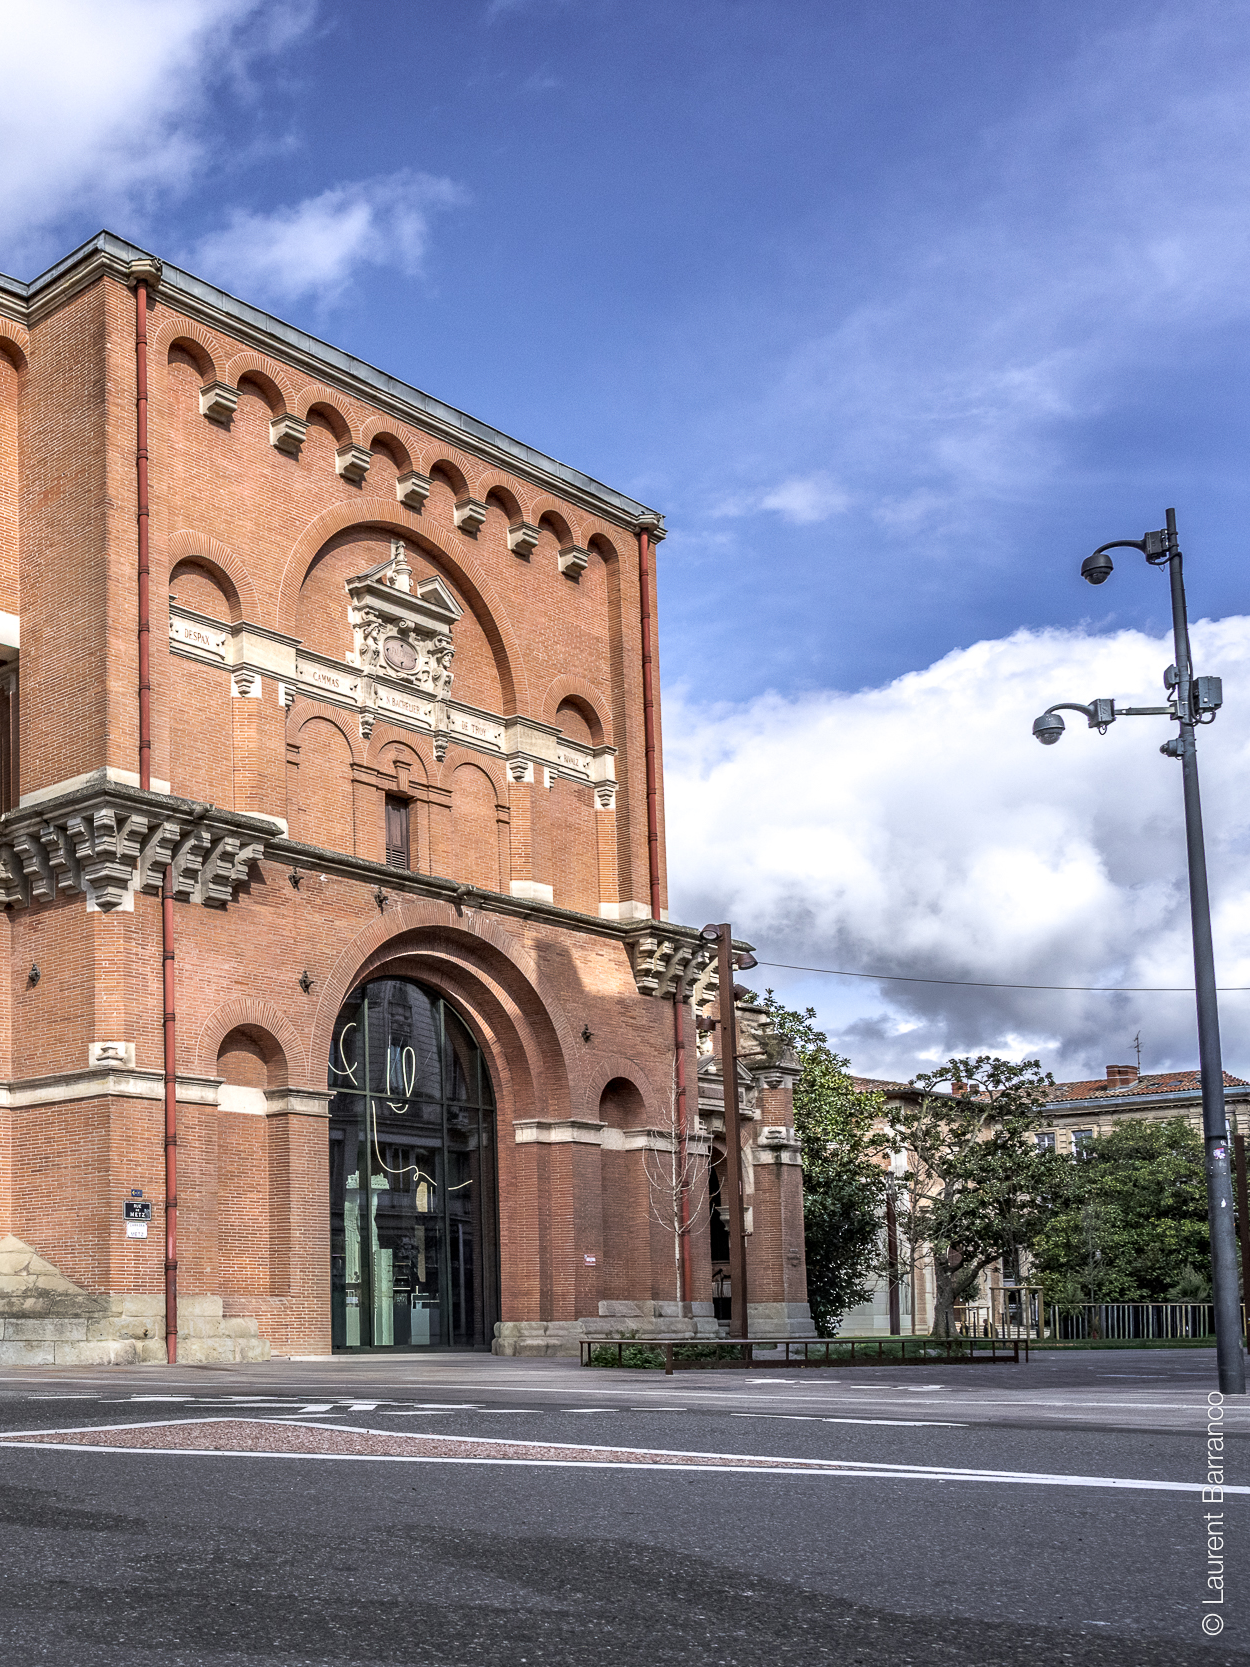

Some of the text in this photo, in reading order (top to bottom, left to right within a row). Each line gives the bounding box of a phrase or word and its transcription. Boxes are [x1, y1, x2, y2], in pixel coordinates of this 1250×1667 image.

[184, 628, 210, 646] DESPAX
[312, 671, 340, 688] CAMMAS
[461, 720, 487, 737] DE TROY
